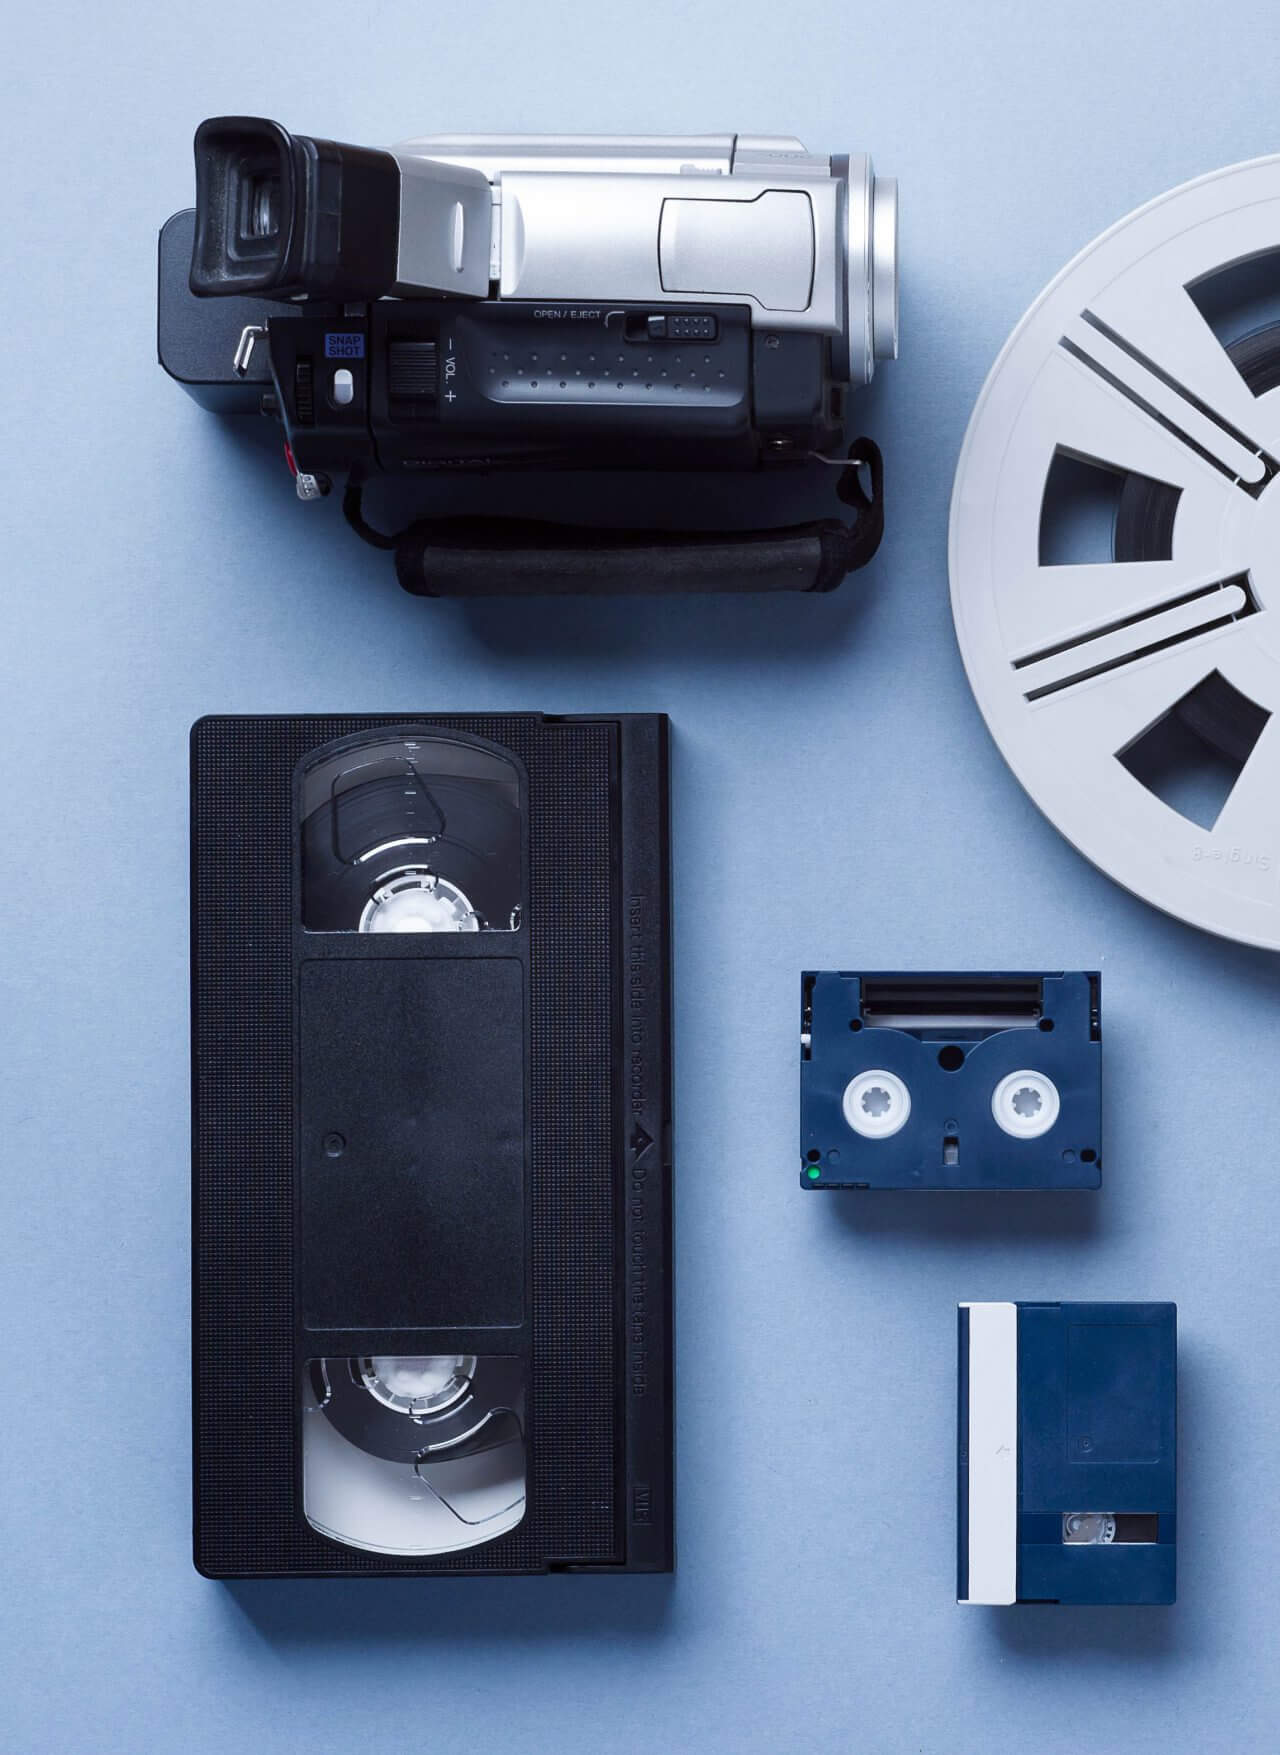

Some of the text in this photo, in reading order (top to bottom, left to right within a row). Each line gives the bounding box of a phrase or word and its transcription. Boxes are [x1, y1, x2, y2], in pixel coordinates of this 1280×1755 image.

[533, 310, 561, 320] OPEN
[570, 310, 601, 320] EJECT
[328, 335, 361, 345] SNAP
[328, 345, 361, 356] SHOT
[445, 356, 456, 385] VOL.
[631, 945, 648, 973] this
[631, 977, 648, 1009] side
[631, 1016, 648, 1043] into
[631, 1050, 648, 1116] recorder
[631, 1168, 648, 1193] Do
[631, 1198, 646, 1223] not
[631, 1279, 648, 1304] the
